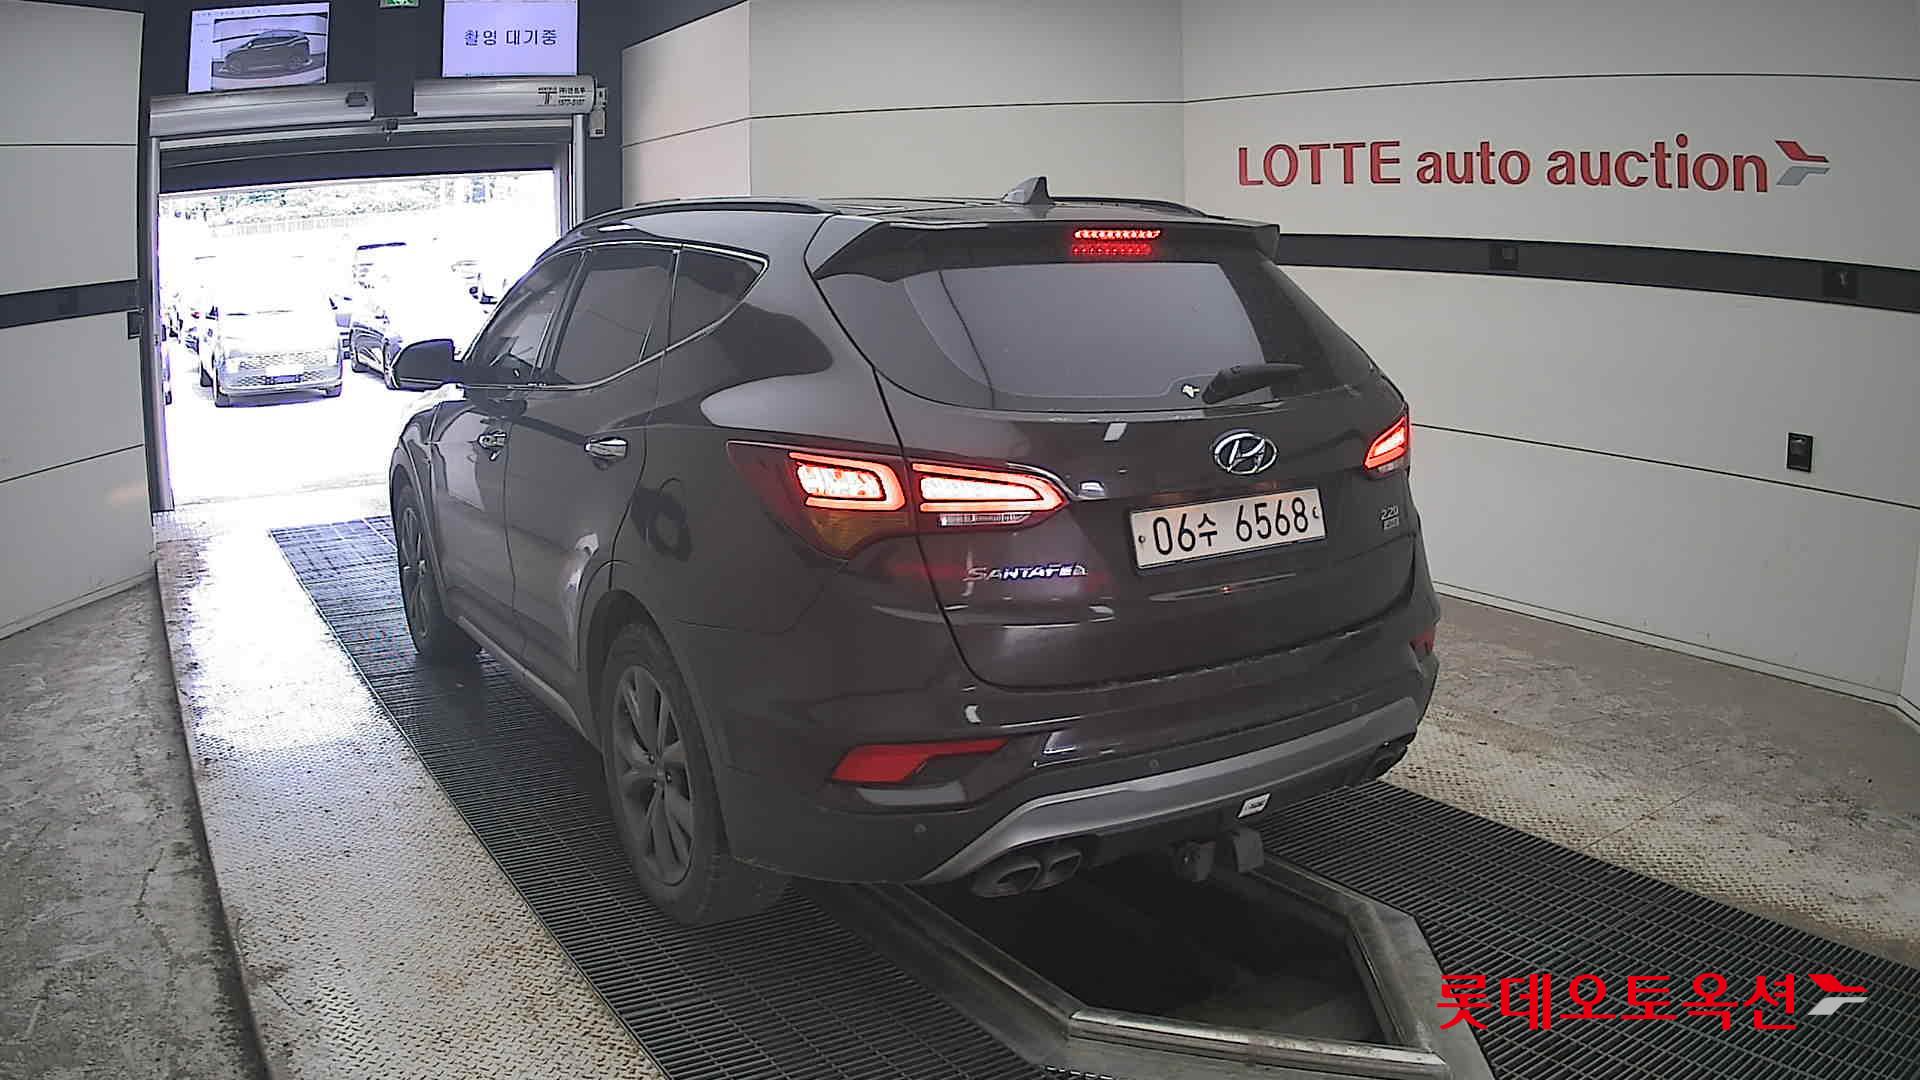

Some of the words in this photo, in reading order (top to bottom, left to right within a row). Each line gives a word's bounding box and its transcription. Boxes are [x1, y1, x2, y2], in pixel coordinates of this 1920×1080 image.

[464, 29, 497, 46] 촬영
[505, 29, 558, 46] 대기중
[1238, 140, 1401, 187] LOTTE
[1416, 140, 1531, 186] auto
[1546, 133, 1769, 193] auction
[1152, 512, 1218, 556] 06수
[1236, 497, 1309, 542] 6568
